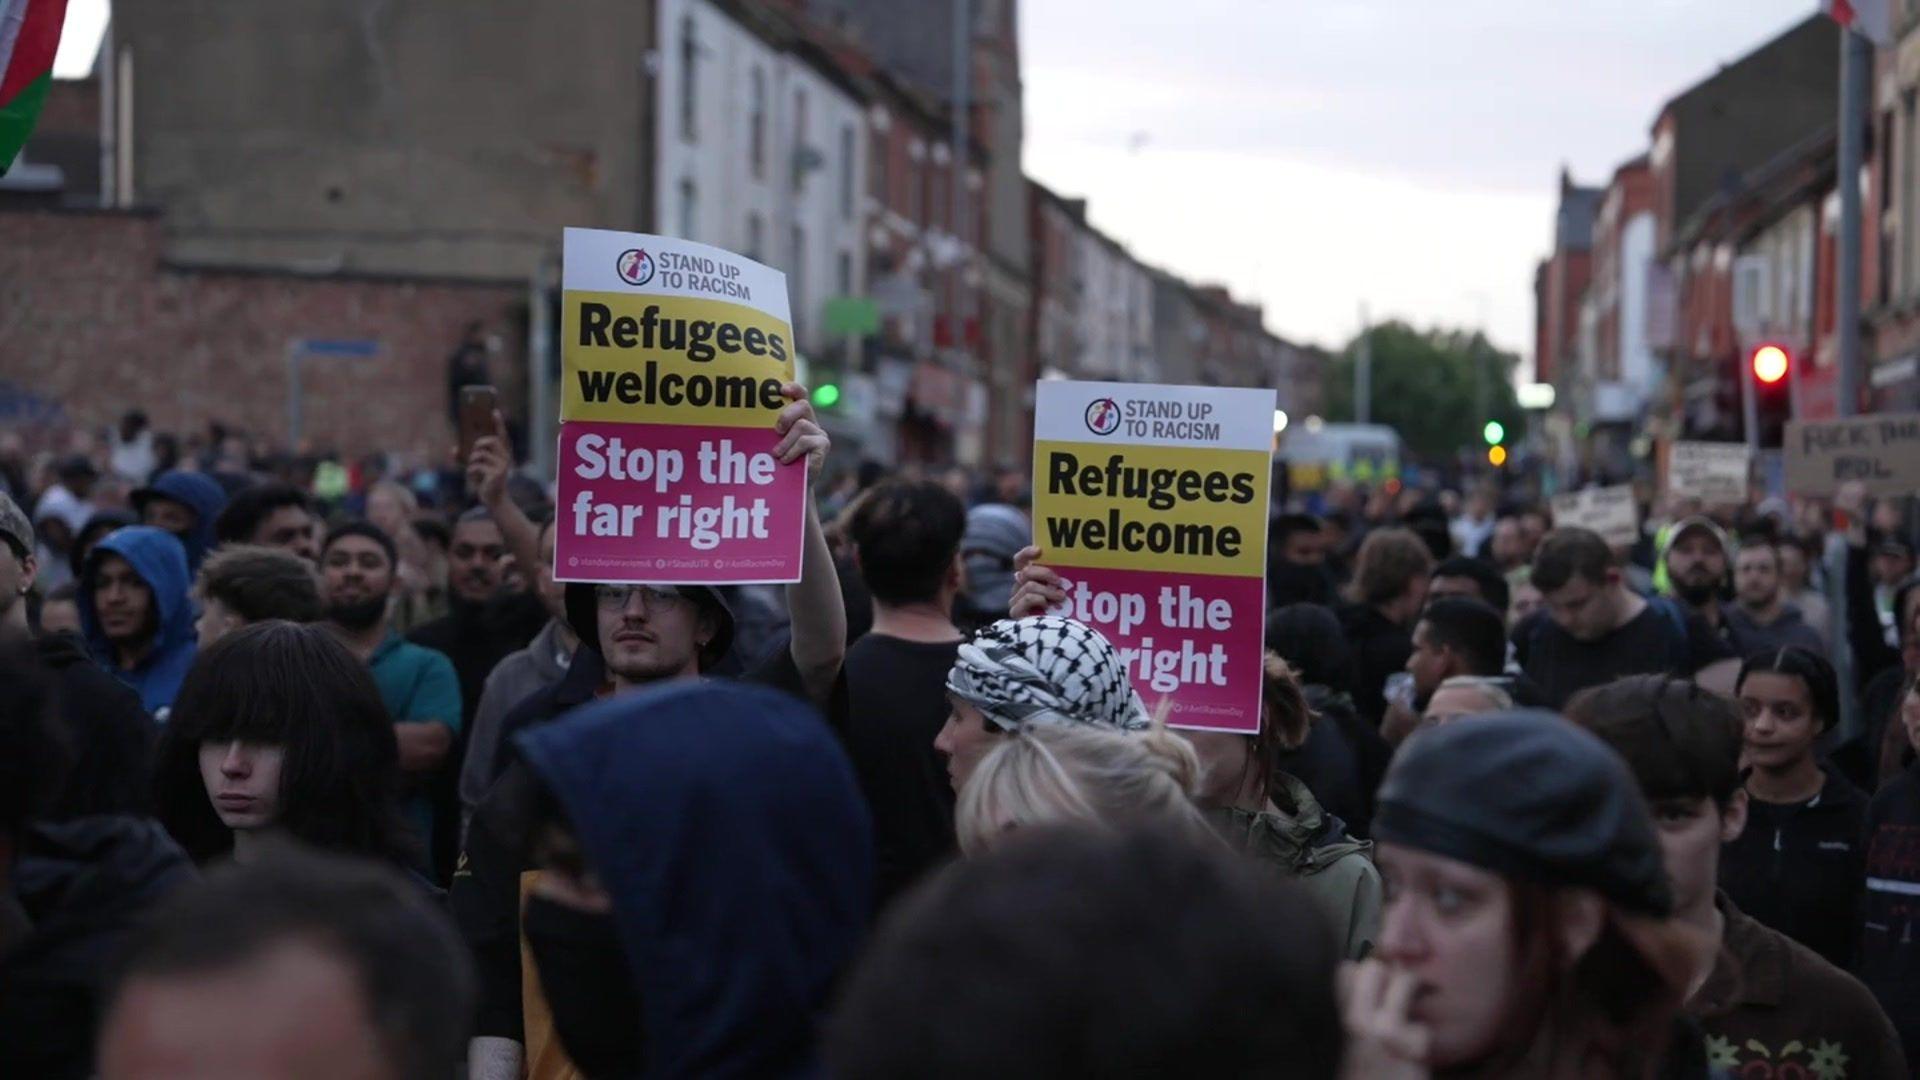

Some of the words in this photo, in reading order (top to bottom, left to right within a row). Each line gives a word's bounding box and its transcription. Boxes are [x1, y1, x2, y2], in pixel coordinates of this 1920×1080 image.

[658, 251, 713, 272] STAND
[718, 262, 741, 279] UP
[660, 270, 683, 289] TO
[687, 274, 751, 300] RACISM
[579, 301, 788, 363] Refugees
[577, 361, 786, 411] welcome
[1125, 400, 1183, 419] STAND
[1187, 403, 1213, 421] UP
[1125, 420, 1149, 437] TO
[1152, 421, 1220, 441] RACISM
[574, 433, 684, 494] Stop
[696, 439, 776, 486] the
[1050, 451, 1255, 511] Refugees
[572, 491, 643, 538] far
[656, 494, 770, 550] right
[1047, 508, 1242, 558] welcome
[1158, 585, 1233, 631] the
[1121, 636, 1228, 693] right
